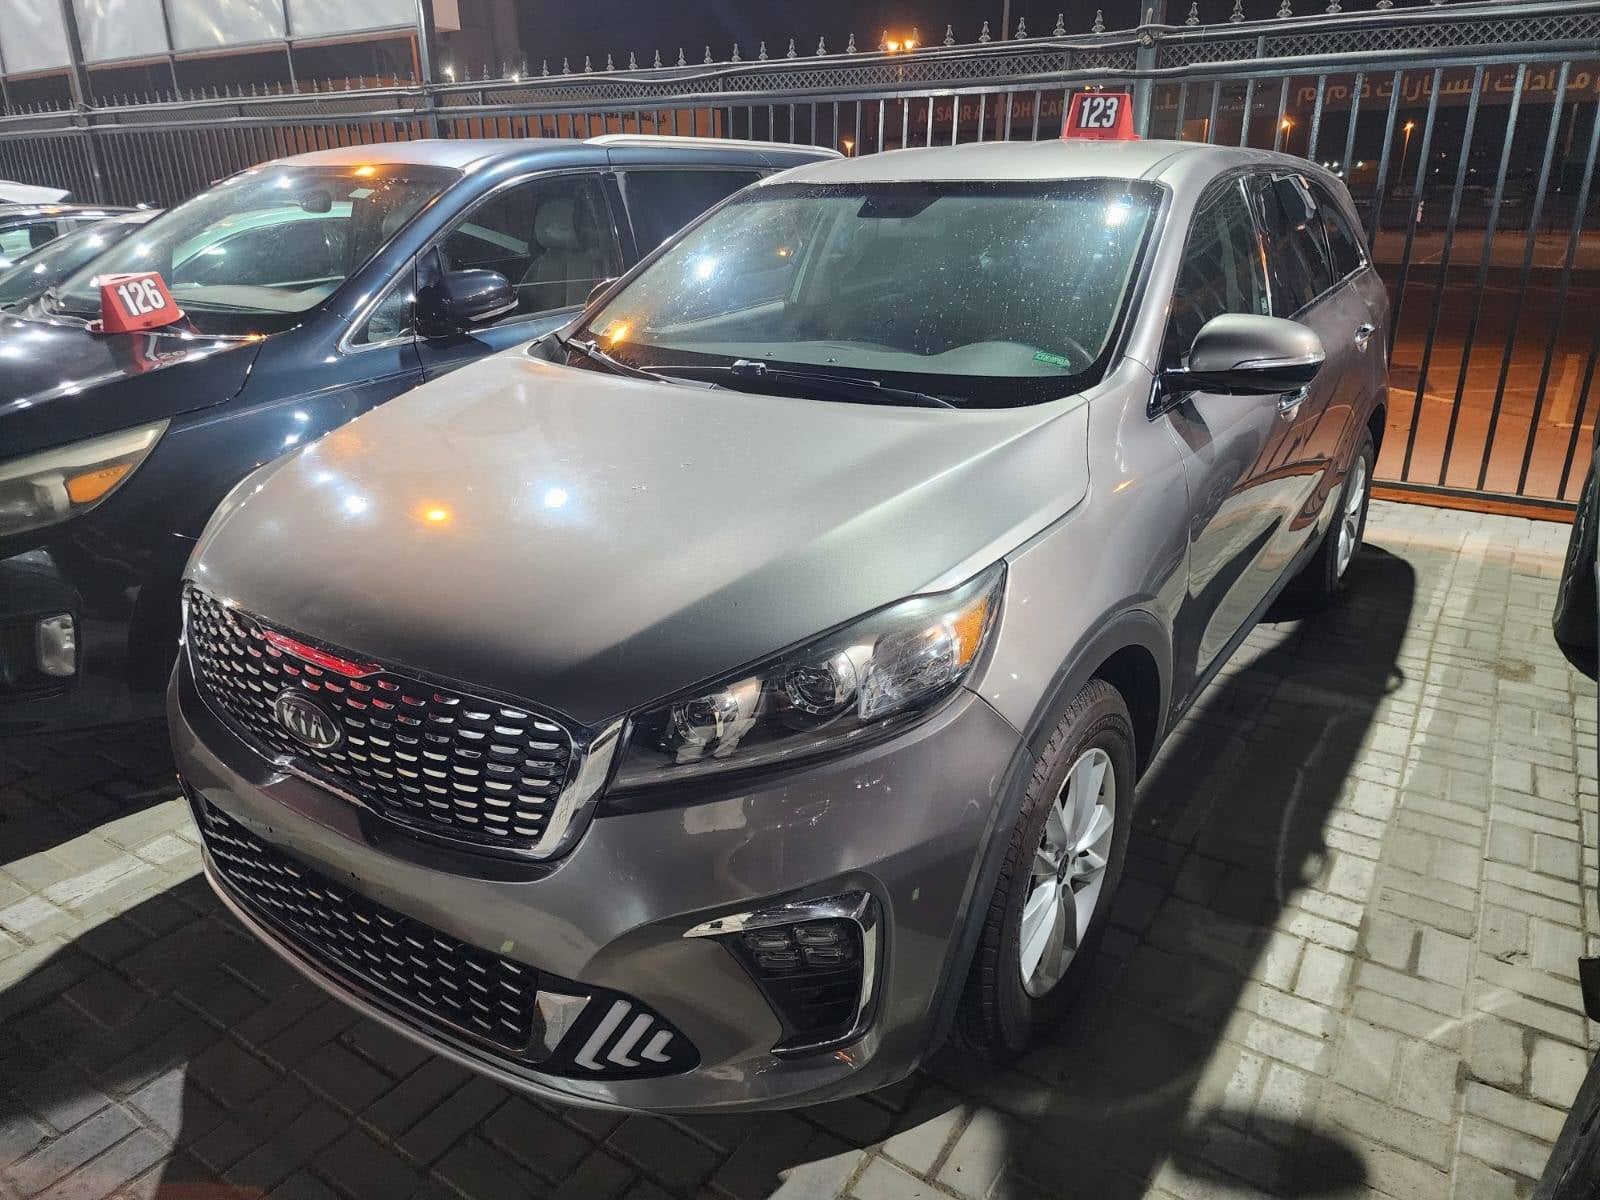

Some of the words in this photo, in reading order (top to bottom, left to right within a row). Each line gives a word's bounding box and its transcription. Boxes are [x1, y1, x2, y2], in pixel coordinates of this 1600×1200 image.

[1376, 71, 1490, 101] اسارات
[936, 104, 972, 122] SAR
[1081, 97, 1118, 128] 123
[118, 278, 165, 316] 126
[281, 701, 328, 743] KIA
